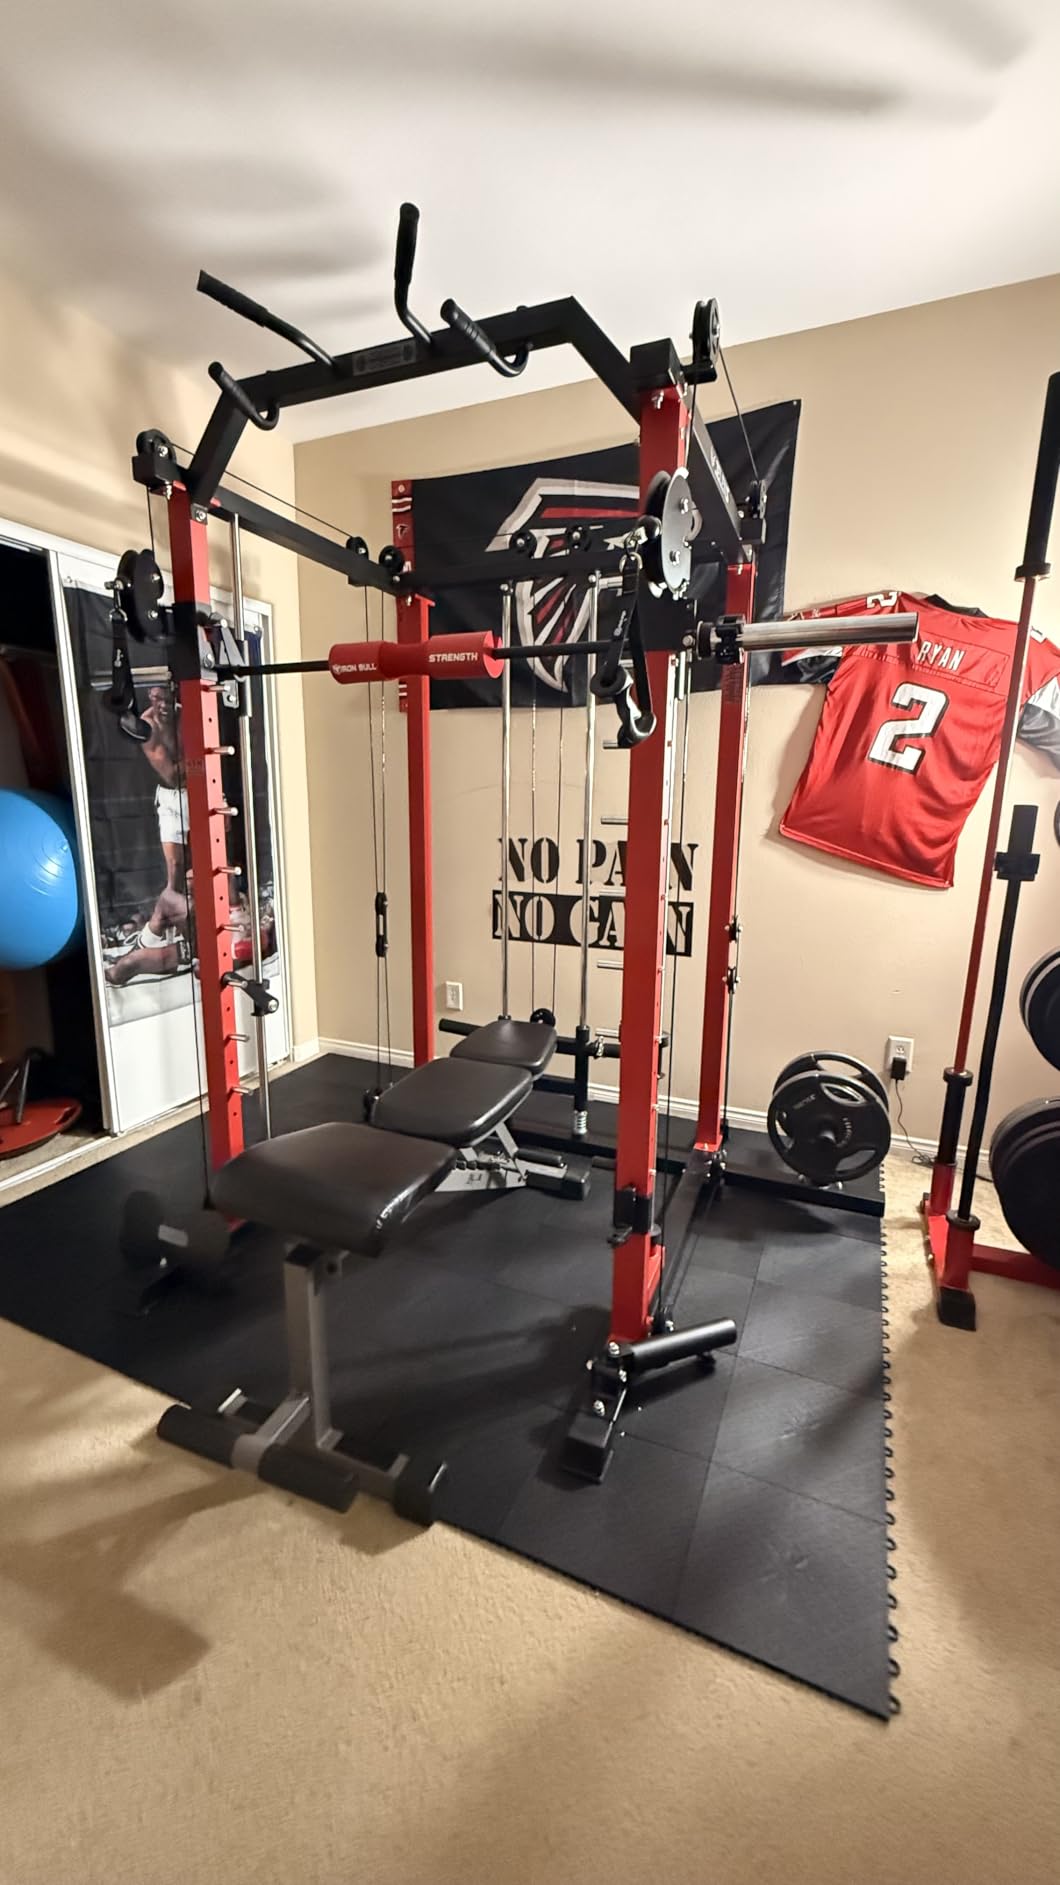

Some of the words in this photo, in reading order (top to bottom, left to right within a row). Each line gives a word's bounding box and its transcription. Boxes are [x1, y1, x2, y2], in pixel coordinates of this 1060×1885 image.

[358, 663, 377, 672] BULL
[428, 652, 478, 663] STRENGTH
[916, 640, 965, 672] RYAN
[867, 681, 949, 775] 2
[498, 837, 560, 884] NO
[575, 838, 699, 891] PAN
[494, 894, 555, 941] NO
[569, 896, 691, 954] GAN
